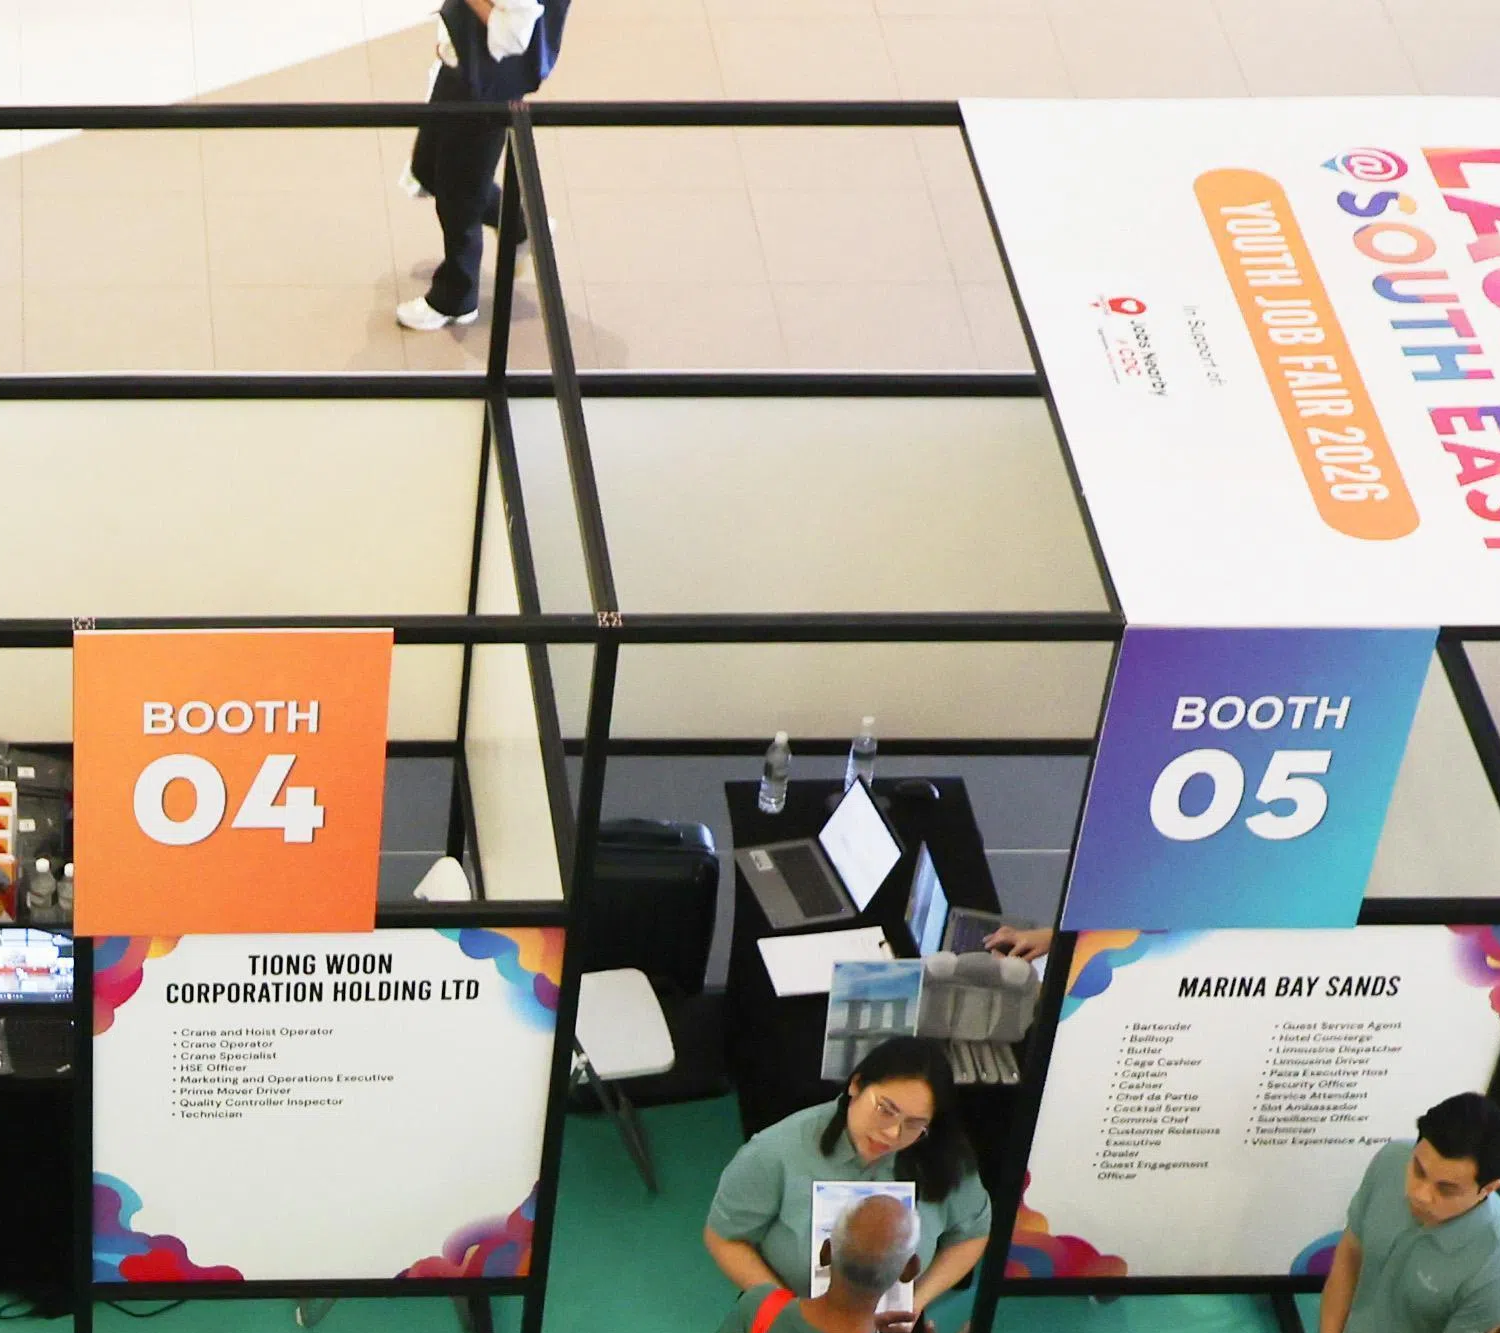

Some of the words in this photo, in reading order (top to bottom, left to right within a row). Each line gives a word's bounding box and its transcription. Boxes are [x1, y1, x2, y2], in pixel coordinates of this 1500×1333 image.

[1220, 201, 1303, 286] YOUTH
[1336, 191, 1494, 381] SOUTH
[1255, 297, 1326, 344] JOB
[1279, 354, 1354, 417] FAIR
[1307, 426, 1389, 502] 2026
[143, 700, 320, 735] BOOTH
[1171, 695, 1351, 731] BOOTH
[132, 753, 325, 846] 04
[1149, 748, 1332, 841] 05
[248, 955, 316, 976] TIONG
[326, 954, 392, 974] WOON
[166, 982, 323, 1003] CORPORATION
[333, 980, 431, 1001] HOLDING
[441, 980, 479, 1000] LTD
[1178, 977, 1268, 998] MARINA
[1275, 976, 1318, 997] BAY
[1326, 974, 1400, 997] SANDS
[220, 1040, 273, 1049] Operator
[280, 1027, 333, 1037] Operator
[220, 1052, 276, 1061] Specialist
[181, 1076, 238, 1084] Marketing
[243, 1075, 264, 1083] and
[268, 1074, 333, 1084] Operations
[180, 1099, 221, 1108] Quality
[226, 1098, 283, 1106] Controller
[288, 1098, 343, 1107] Inspector
